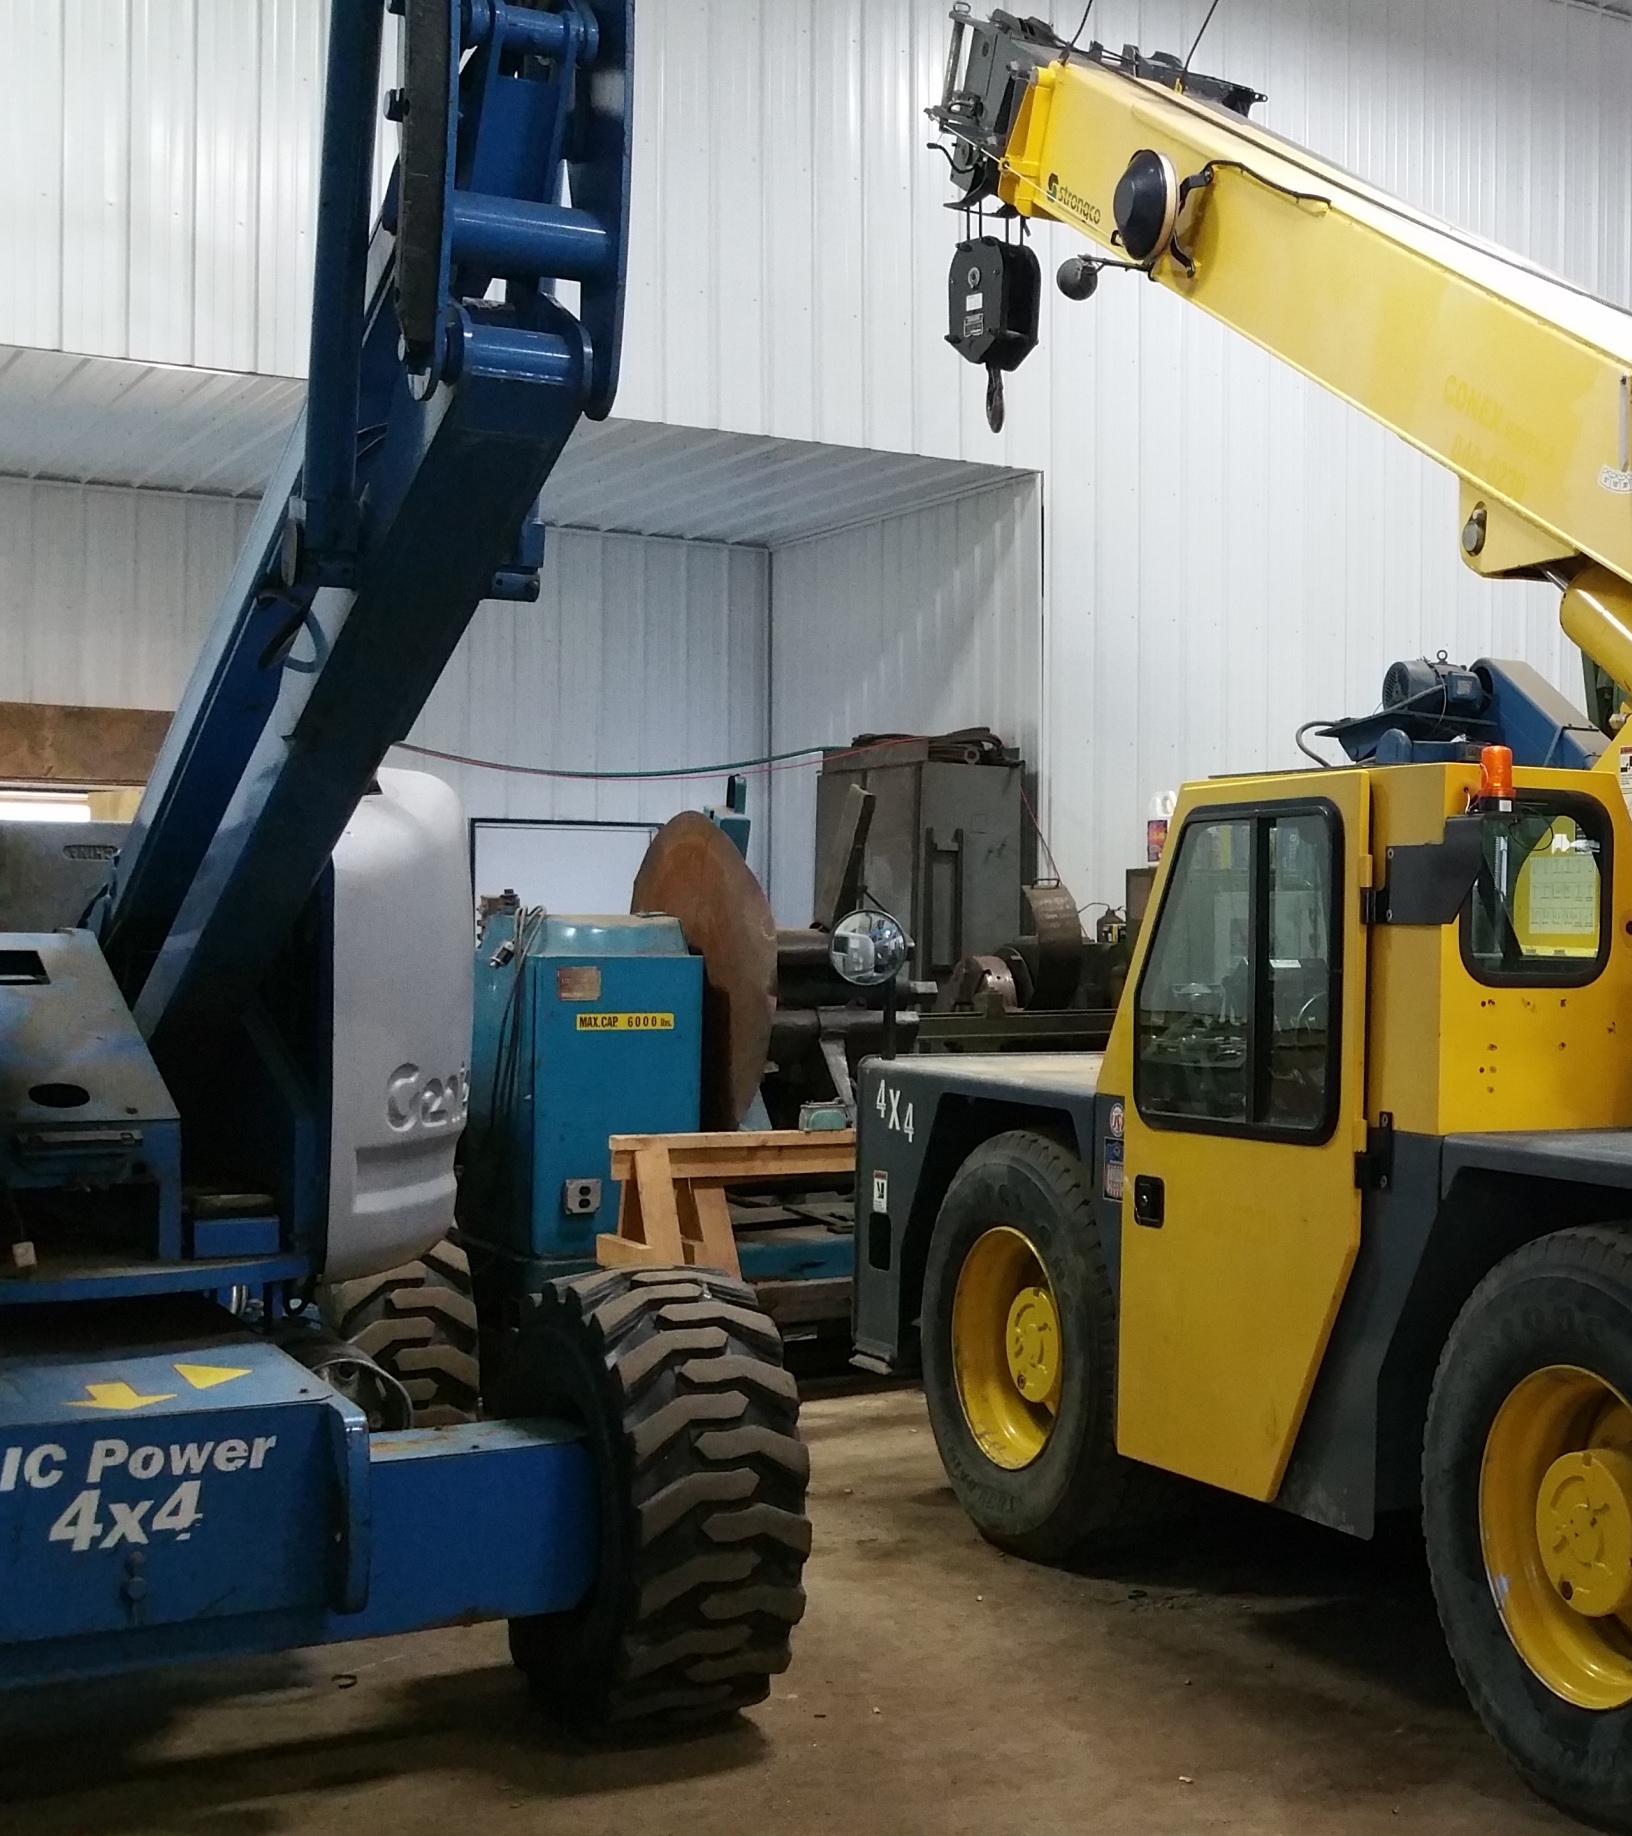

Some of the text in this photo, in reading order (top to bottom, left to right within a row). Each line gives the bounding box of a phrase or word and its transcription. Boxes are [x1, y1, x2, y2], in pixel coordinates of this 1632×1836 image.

[627, 1015, 657, 1027] 6000
[876, 1079, 914, 1143] 4X4
[0, 1434, 277, 1492] IC Power
[48, 1479, 203, 1553] 4x4
